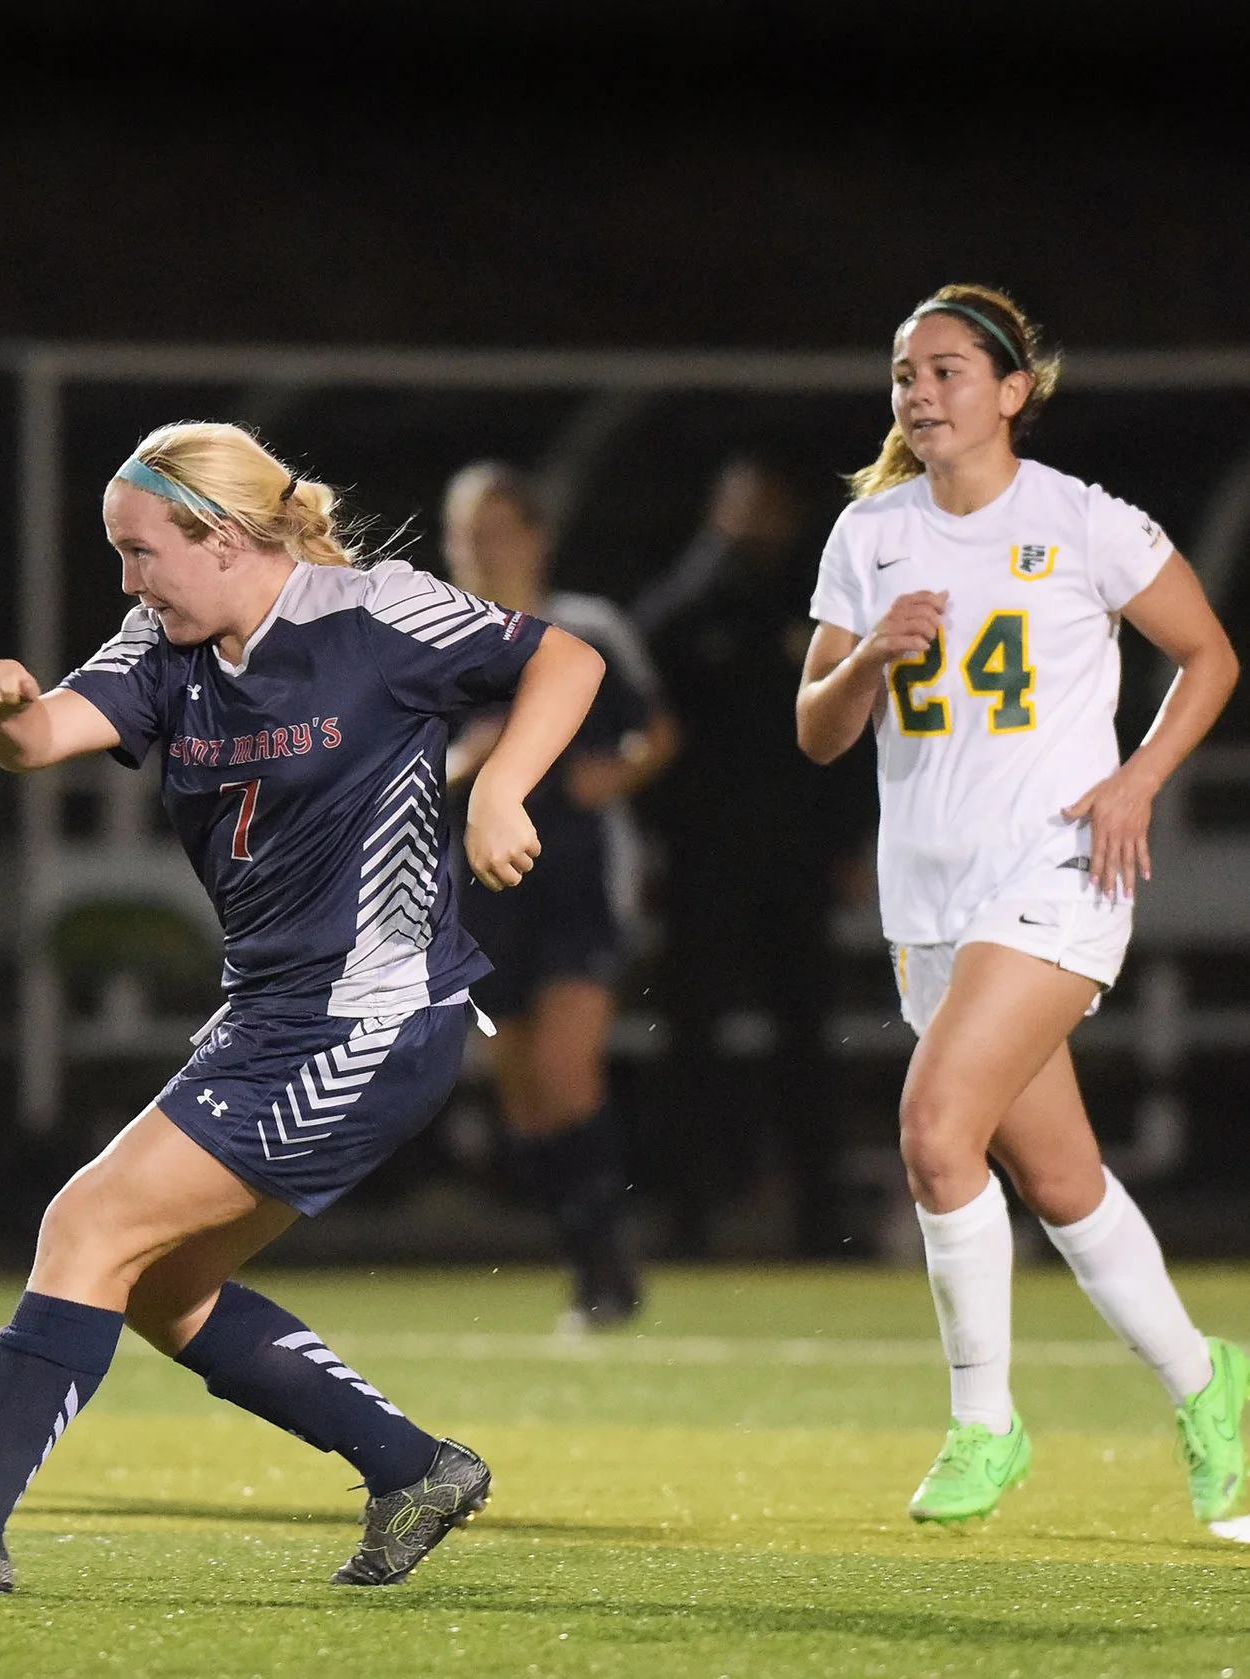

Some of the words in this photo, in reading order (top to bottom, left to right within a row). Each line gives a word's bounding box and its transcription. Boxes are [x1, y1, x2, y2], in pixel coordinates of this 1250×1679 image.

[888, 609, 1037, 736] 24
[229, 717, 342, 765] MARY'S
[220, 778, 261, 862] 7
